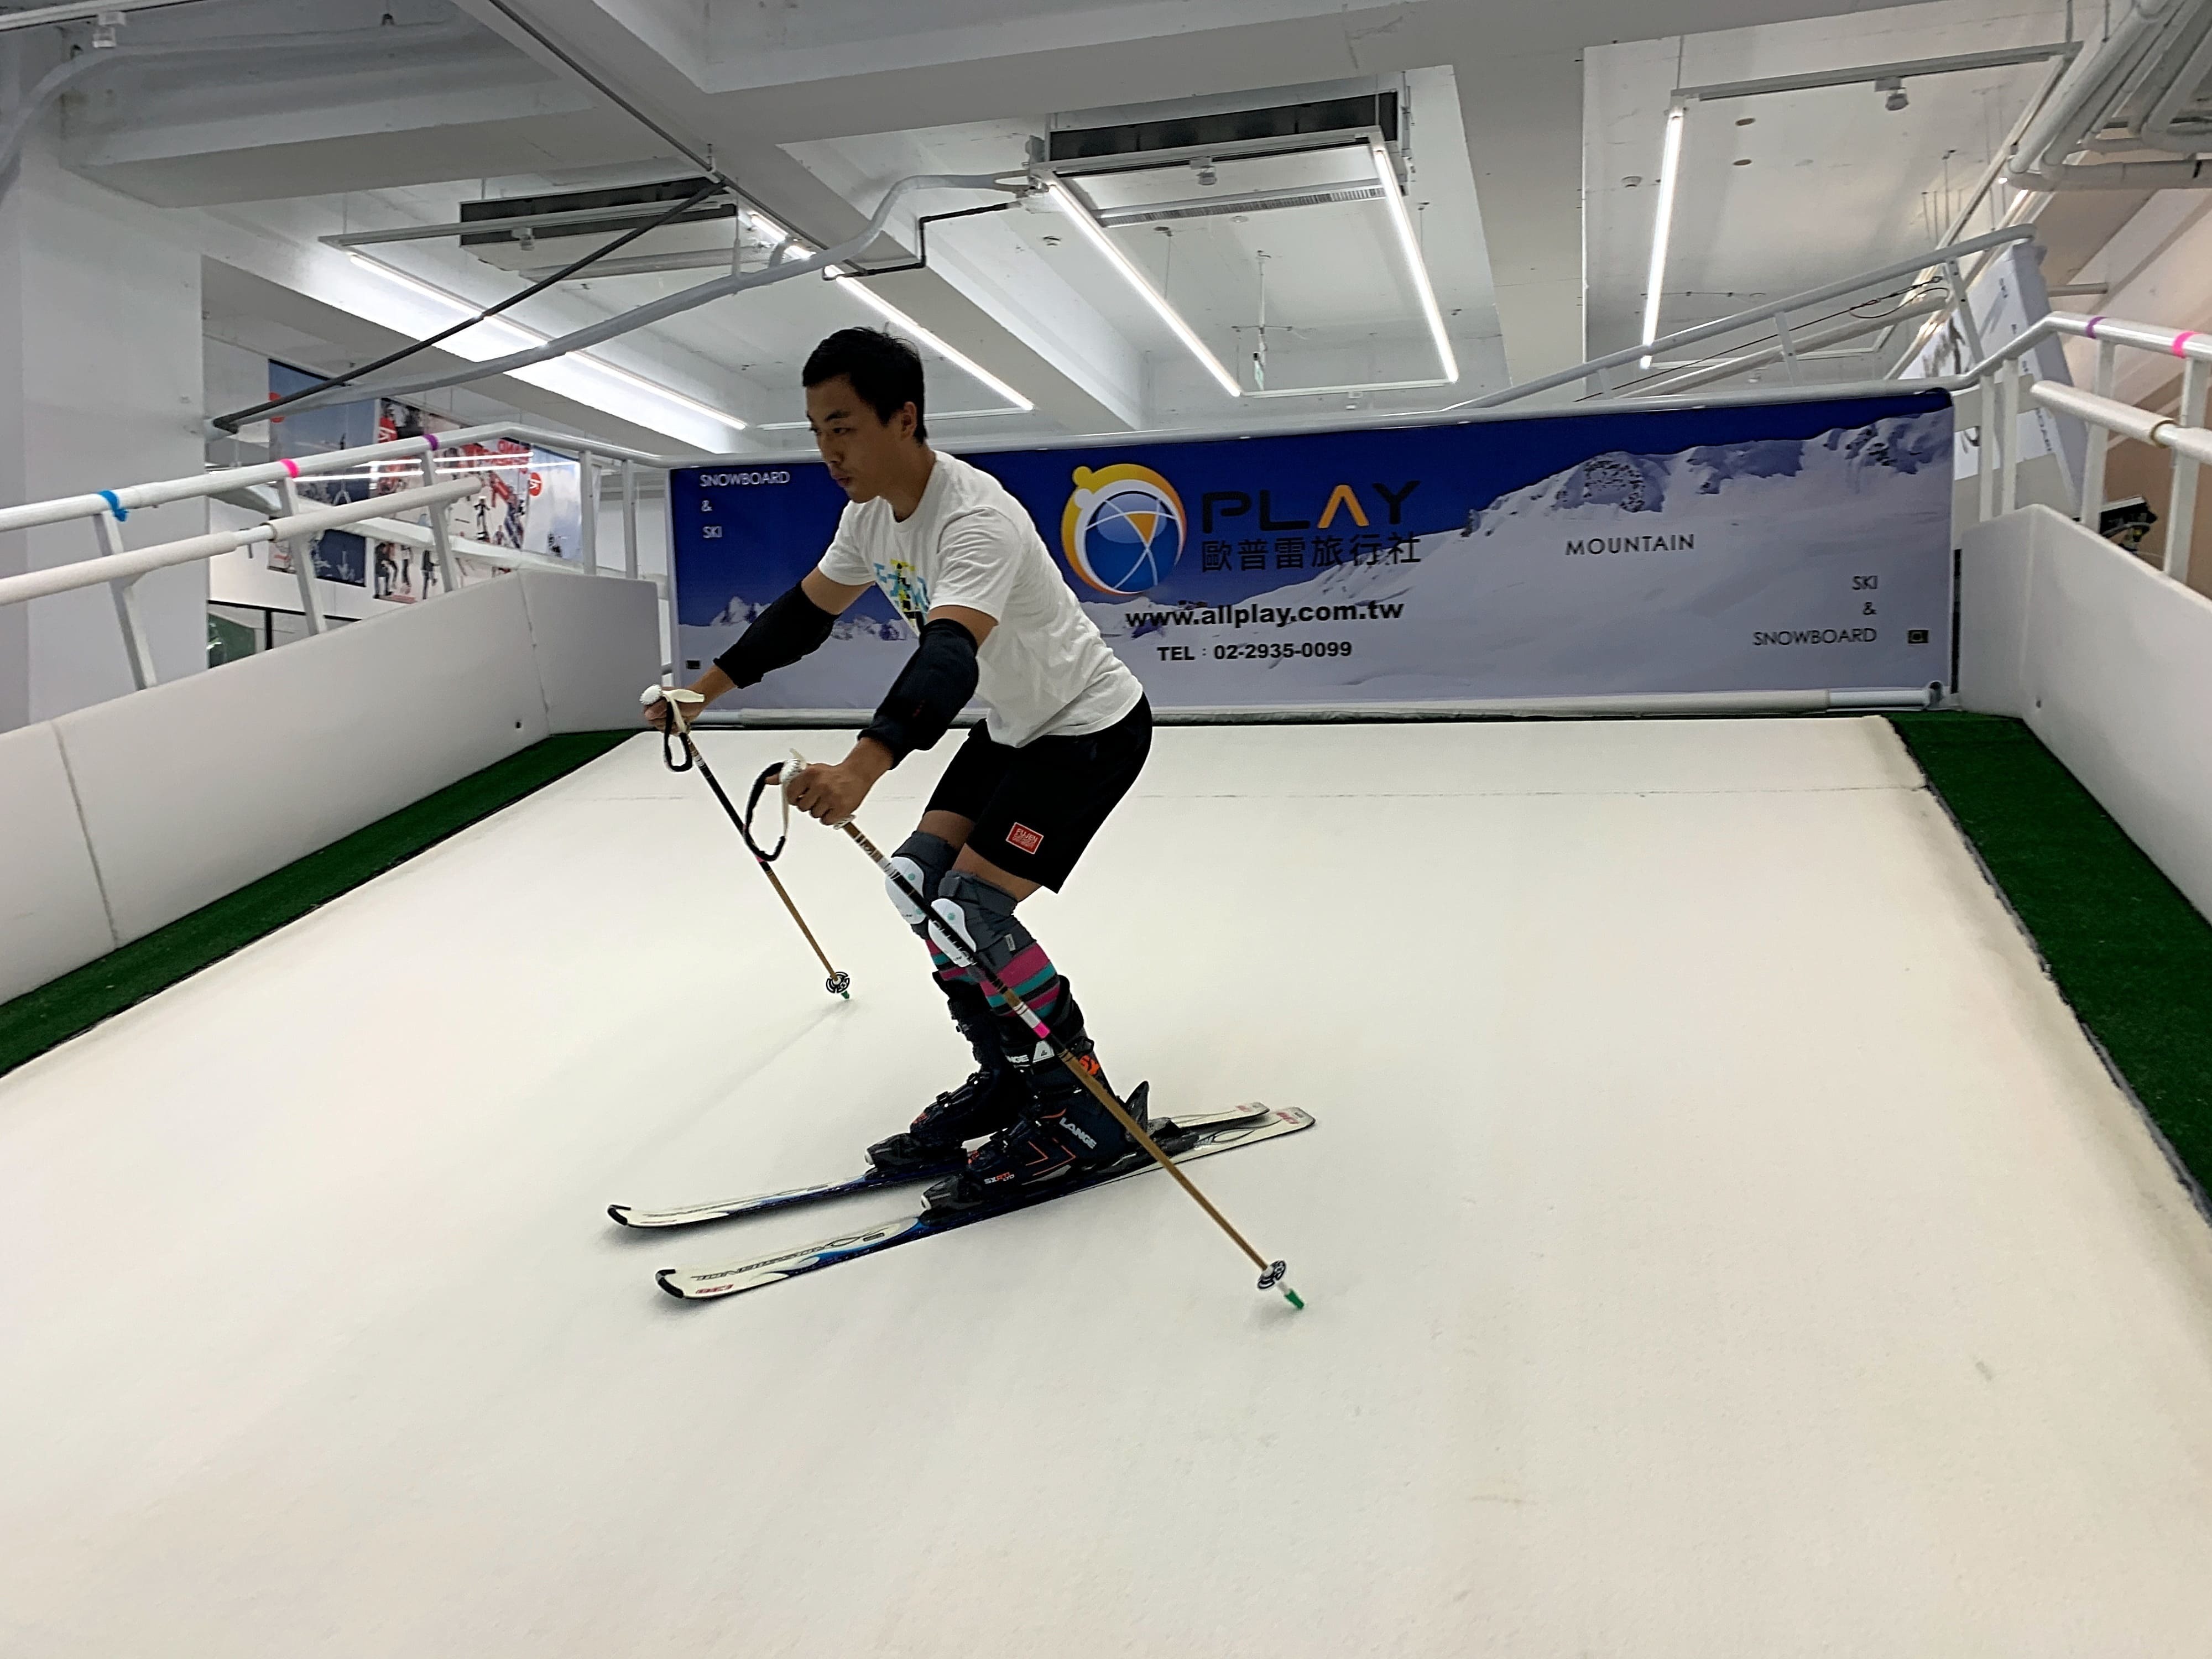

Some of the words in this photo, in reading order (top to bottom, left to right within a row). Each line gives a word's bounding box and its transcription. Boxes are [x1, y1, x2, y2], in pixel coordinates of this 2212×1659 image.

[700, 471, 790, 487] SNOWBOARD
[702, 500, 712, 512] &
[703, 526, 722, 539] SKI
[1202, 532, 1421, 572] 歐普雷旅行社
[1566, 534, 1695, 556] MOUNTAIN
[1852, 576, 1877, 591] SKI
[1126, 600, 1404, 628] www.allplay.com.tw
[1863, 602, 1876, 616] &
[1752, 628, 1877, 646] SNOWBOARD
[1214, 642, 1352, 660] 02-2935-0099
[1059, 1118, 1097, 1149] LANGE
